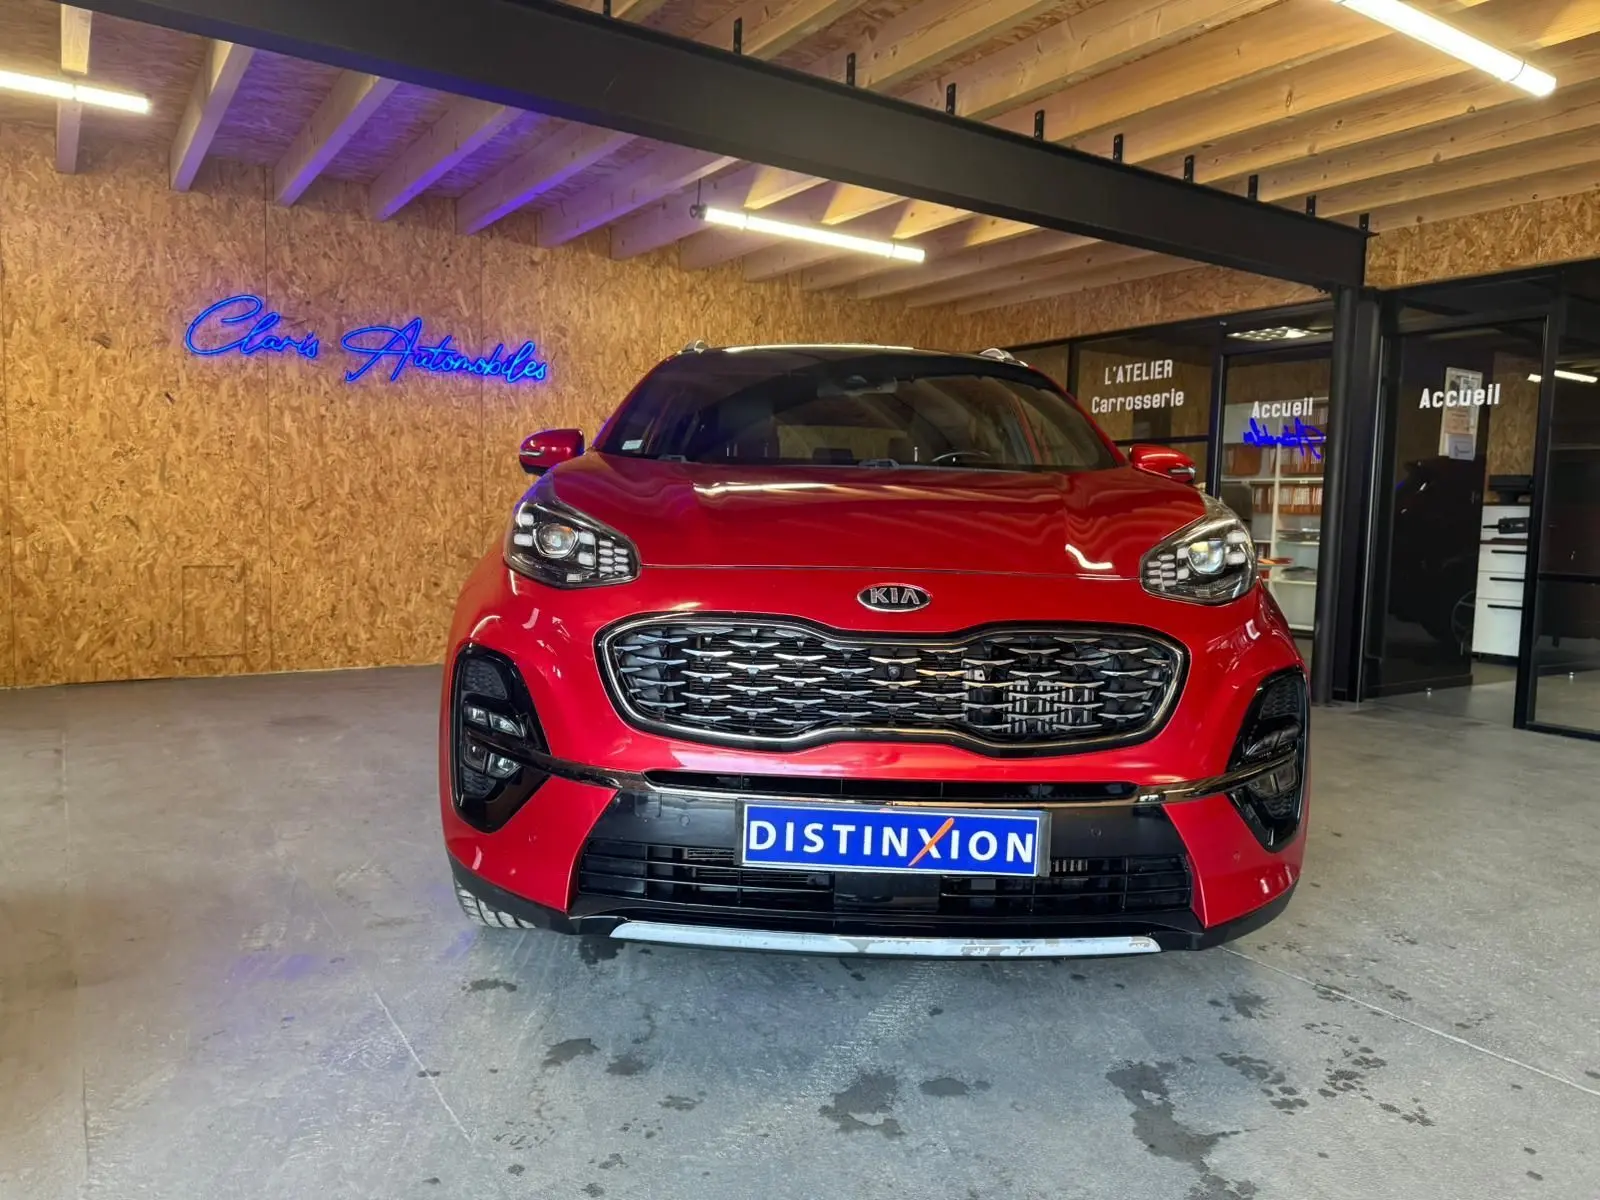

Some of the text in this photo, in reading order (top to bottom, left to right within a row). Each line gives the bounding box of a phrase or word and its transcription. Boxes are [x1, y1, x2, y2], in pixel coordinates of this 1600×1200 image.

[184, 294, 548, 383] Claris Automobiles
[1104, 359, 1174, 385] L'ATELIER
[1091, 388, 1185, 414] Carrosserie
[1251, 397, 1314, 418] Accueil
[1419, 383, 1501, 409] Accueil
[869, 587, 921, 604] KIA
[748, 816, 1034, 867] DISTINXION
